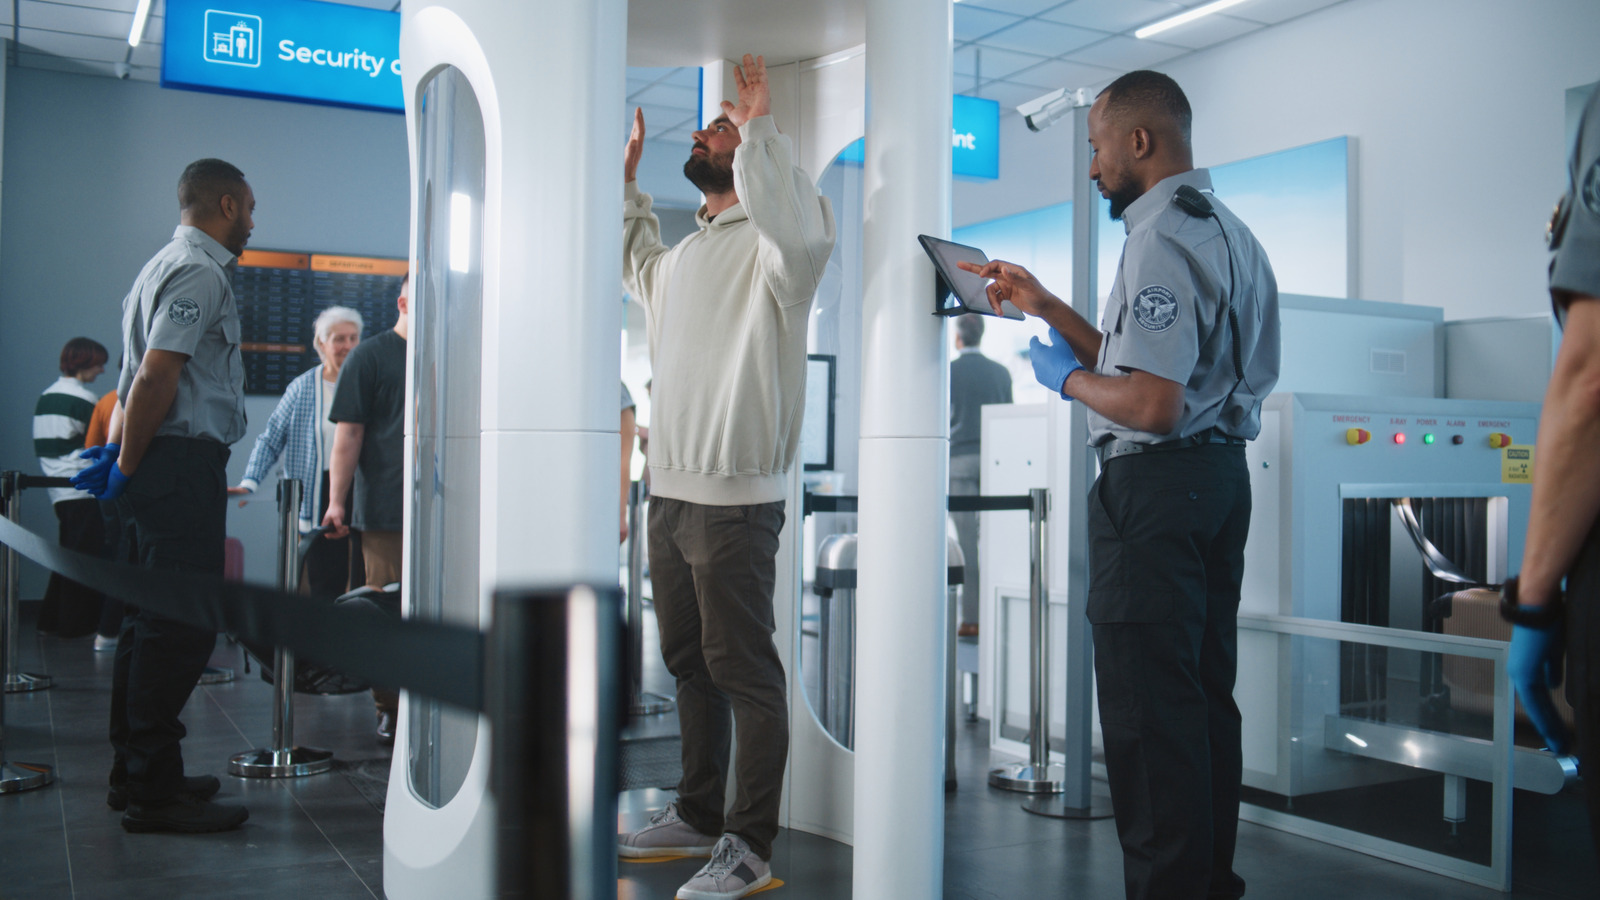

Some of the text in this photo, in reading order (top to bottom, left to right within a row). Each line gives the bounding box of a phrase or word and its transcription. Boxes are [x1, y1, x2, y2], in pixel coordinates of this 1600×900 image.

[278, 39, 385, 77] Security
[1147, 287, 1173, 298] AIRPORT
[1138, 317, 1166, 330] SECURITY
[1332, 415, 1371, 424] EMERGENCY
[1416, 418, 1437, 426] POWER
[1478, 420, 1511, 428] EMERGENCY
[1508, 450, 1529, 458] CAUTION
